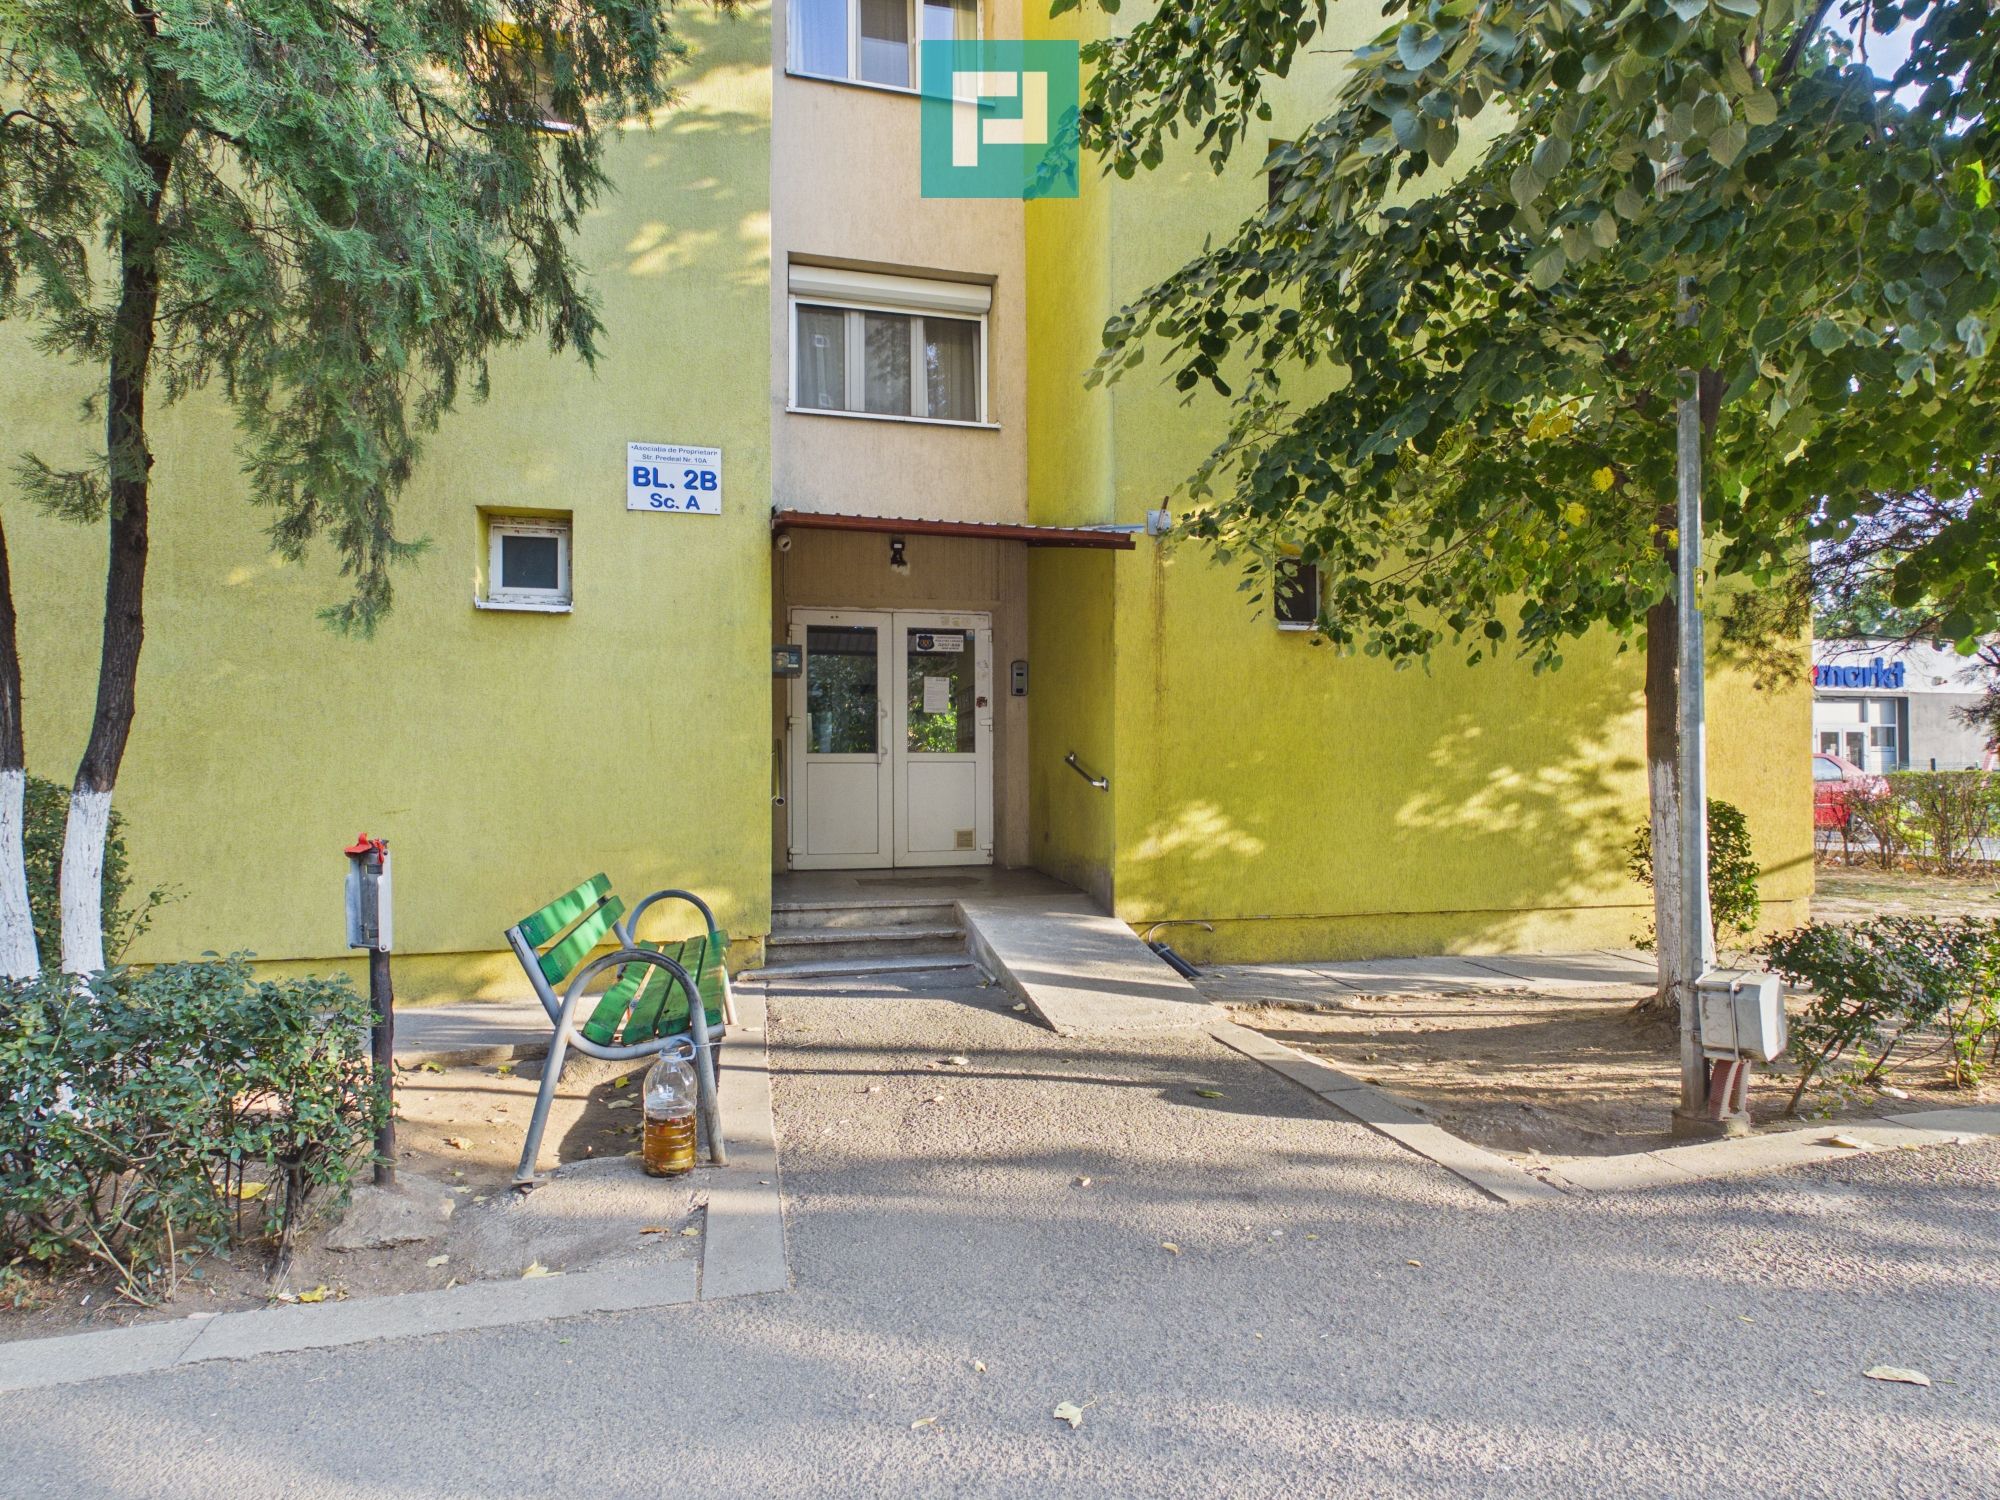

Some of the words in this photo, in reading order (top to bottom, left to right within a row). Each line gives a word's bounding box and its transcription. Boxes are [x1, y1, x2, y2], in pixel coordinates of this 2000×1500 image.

[633, 466, 674, 489] BL.
[684, 469, 717, 491] 2B
[650, 492, 679, 509] Sc.
[686, 495, 700, 510] A
